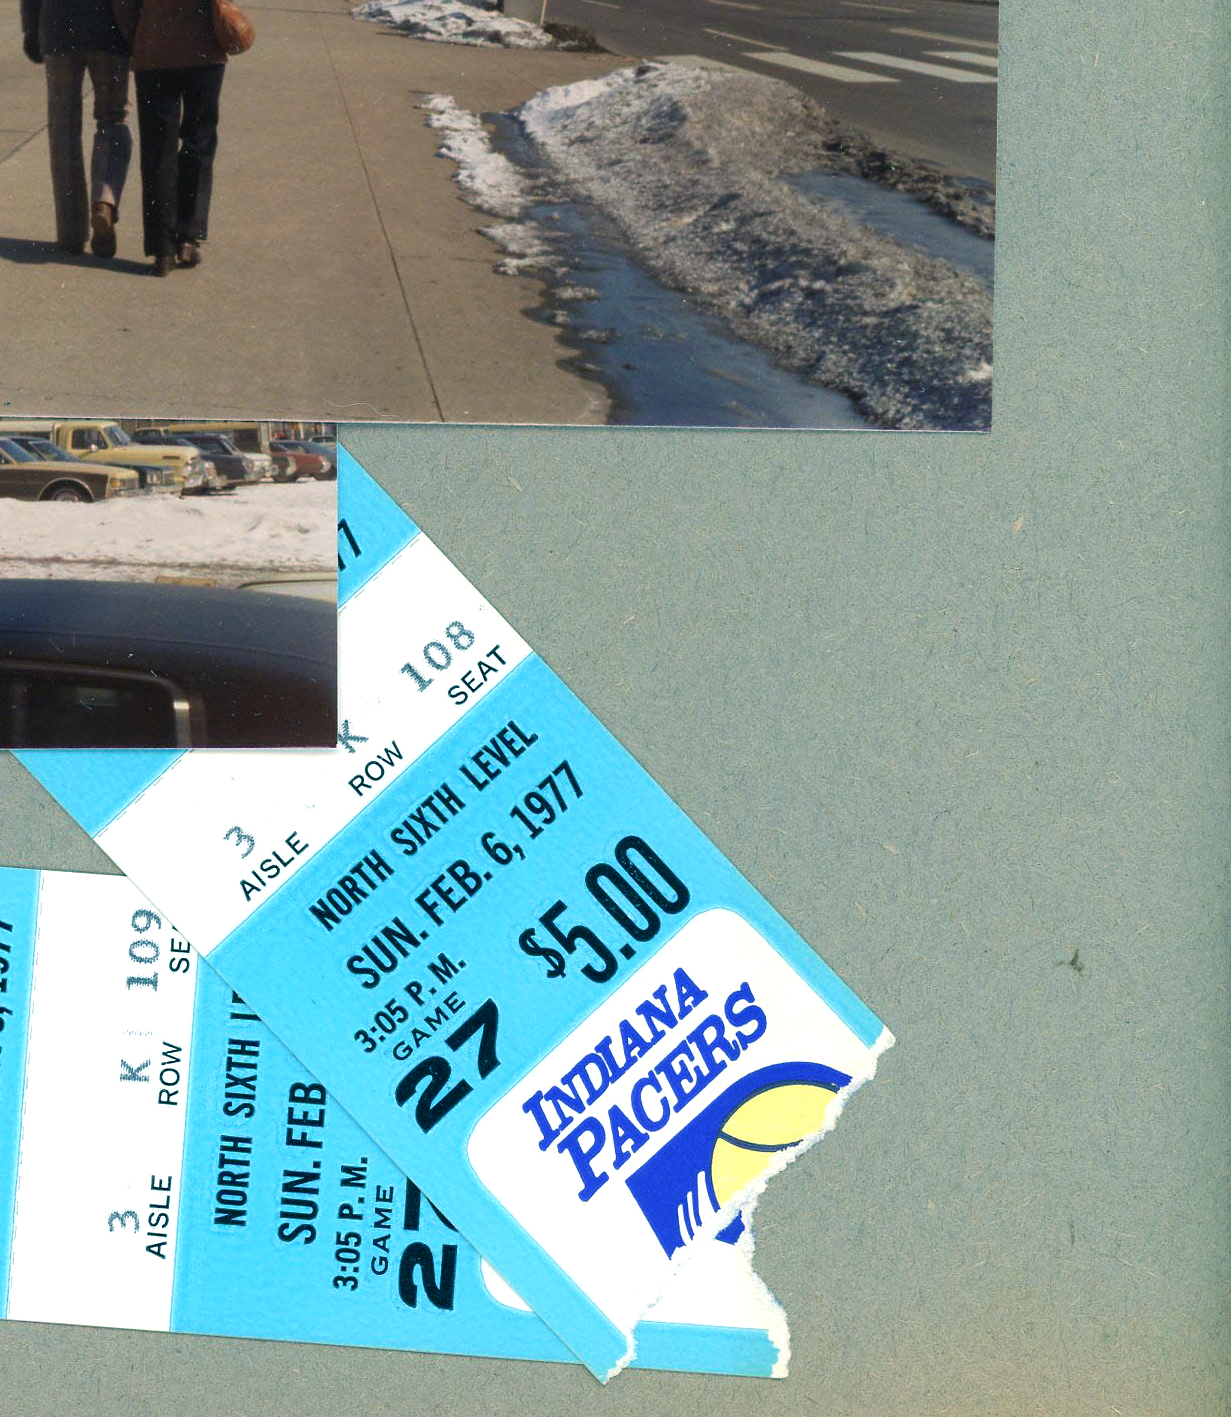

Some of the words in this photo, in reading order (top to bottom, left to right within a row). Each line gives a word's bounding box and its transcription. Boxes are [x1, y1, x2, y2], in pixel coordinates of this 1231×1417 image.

[224, 827, 254, 858] 3
[338, 720, 368, 752] K
[401, 621, 474, 692] 108
[241, 832, 308, 900] AISLE
[349, 741, 402, 796] ROW
[448, 645, 505, 704] SEAT
[309, 852, 394, 931] NORTH
[391, 784, 465, 855] SIXTH
[460, 721, 538, 791] LEVEL
[347, 922, 428, 989] SUN.
[415, 862, 492, 926] FEB.
[482, 833, 525, 865] 6,
[511, 761, 583, 839] 1977
[519, 836, 690, 983] $5.00
[127, 910, 161, 989] 109
[169, 925, 191, 974] SE
[355, 999, 408, 1052] 3:05
[393, 991, 465, 1060] GAME
[395, 999, 500, 1133] 27
[523, 968, 708, 1151] INDIANA
[120, 1062, 149, 1081] K
[159, 1042, 181, 1105] ROW
[223, 1039, 260, 1118] SIXTH
[558, 982, 766, 1201] PACERS
[108, 1211, 139, 1231] 3
[146, 1176, 171, 1259] AISLE
[214, 1135, 252, 1226] NORTH
[278, 1162, 321, 1244] SUN.
[333, 1232, 361, 1290] 3:05
[371, 1186, 393, 1275] GAME
